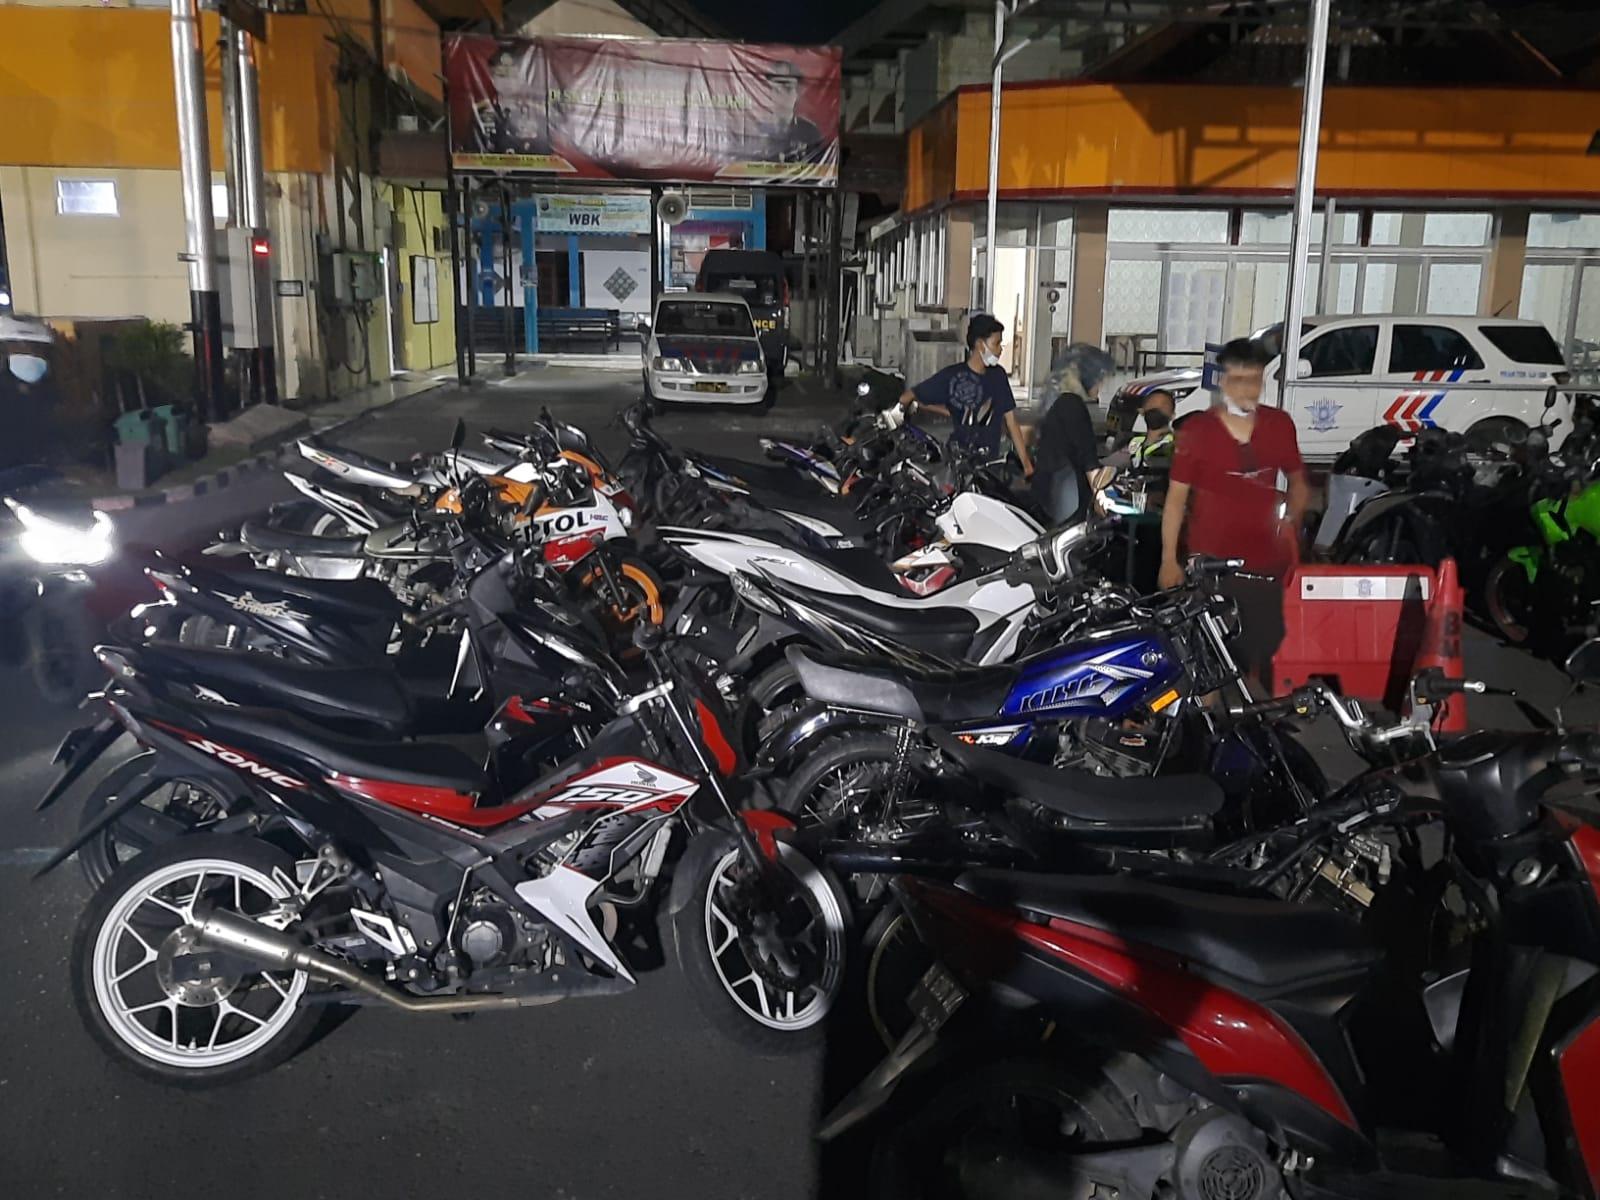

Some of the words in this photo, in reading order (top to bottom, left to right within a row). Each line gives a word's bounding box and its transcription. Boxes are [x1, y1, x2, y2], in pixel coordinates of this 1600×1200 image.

[569, 213, 601, 227] WBK
[187, 739, 305, 788] SONIC
[630, 780, 657, 788] HONDA
